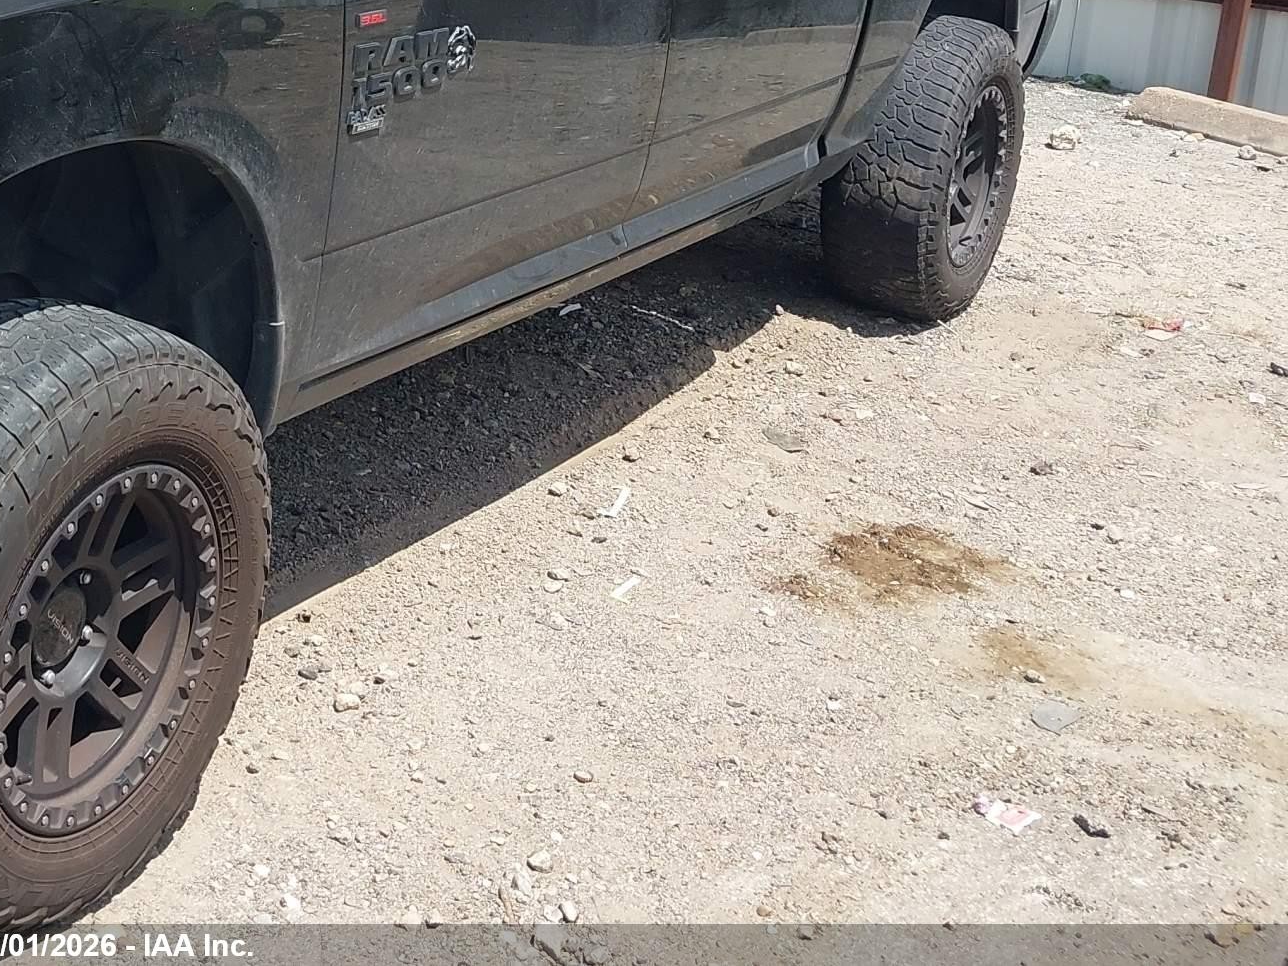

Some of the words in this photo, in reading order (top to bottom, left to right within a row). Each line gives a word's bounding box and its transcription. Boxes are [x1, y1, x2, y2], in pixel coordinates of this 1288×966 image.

[352, 26, 450, 77] RAM
[351, 57, 448, 113] 1500
[47, 608, 74, 644] VISION
[115, 648, 150, 685] VISION
